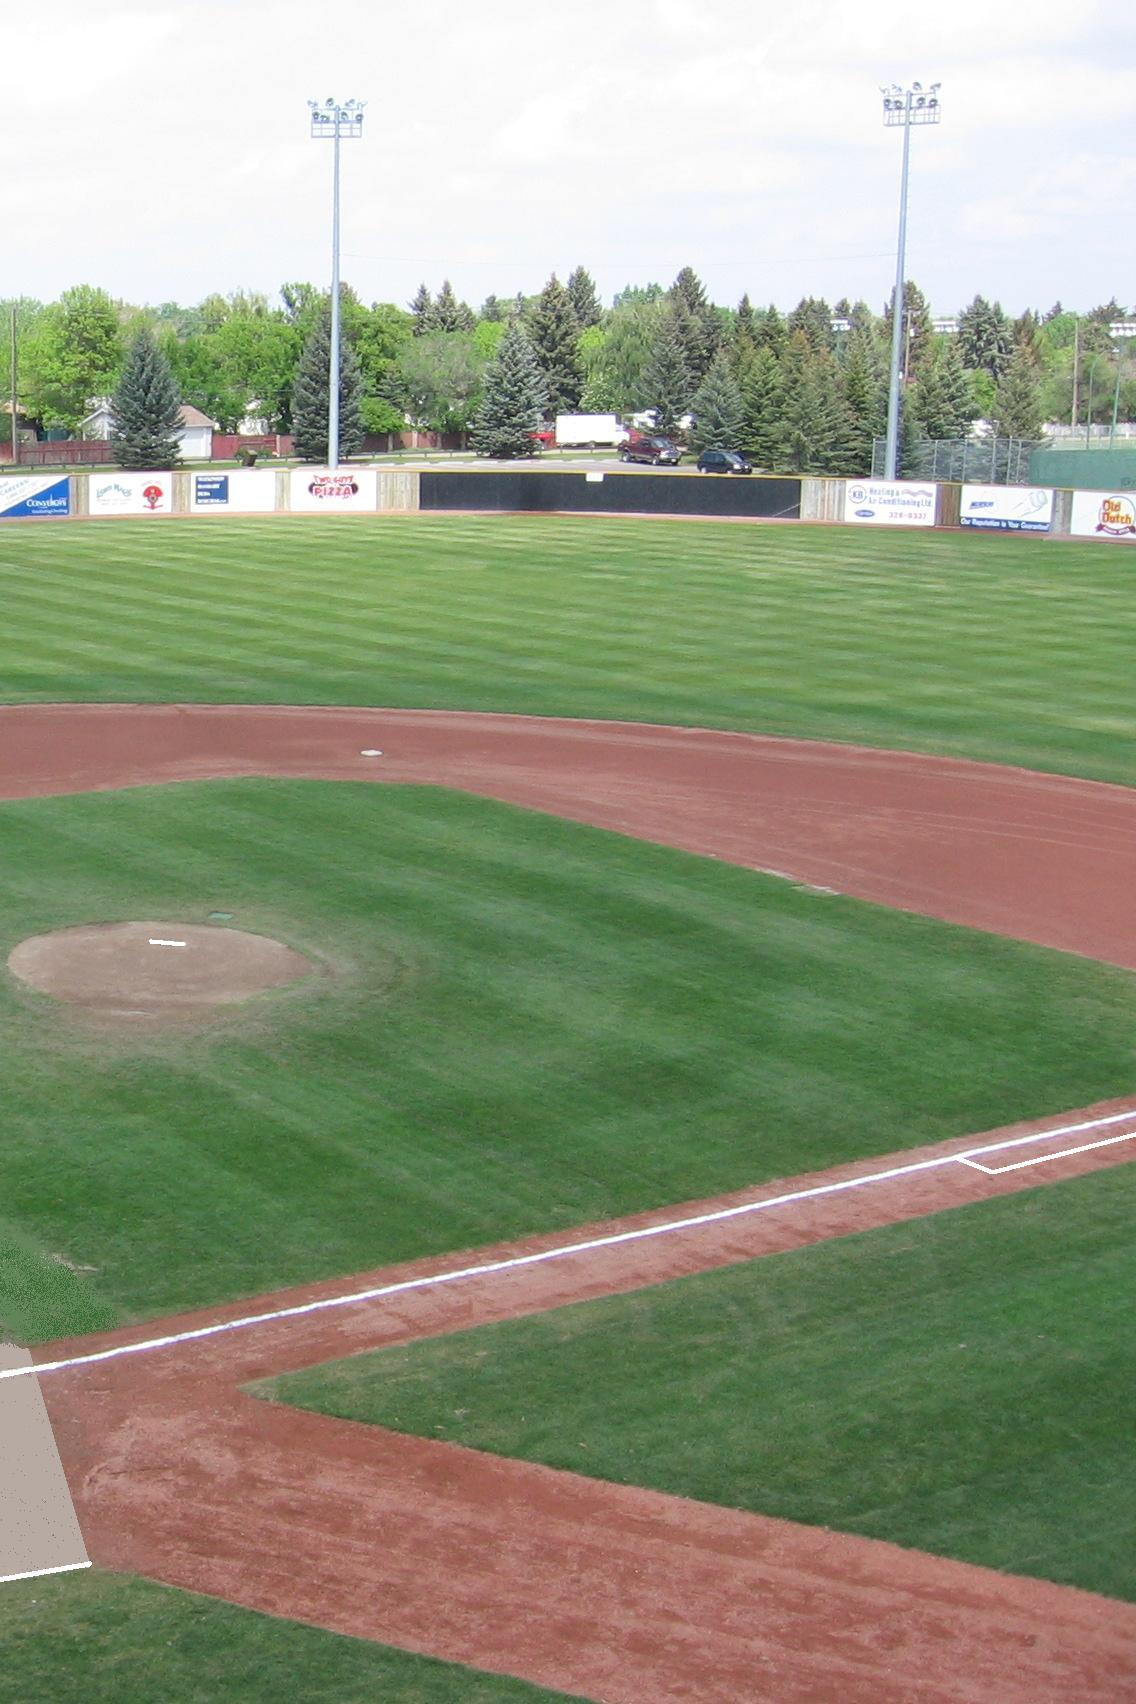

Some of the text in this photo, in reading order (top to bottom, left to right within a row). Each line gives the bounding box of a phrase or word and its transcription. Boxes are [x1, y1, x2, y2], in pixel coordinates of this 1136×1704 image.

[314, 487, 351, 496] PIZZA
[1102, 499, 1121, 512] Old
[1102, 512, 1132, 524] Dutch
